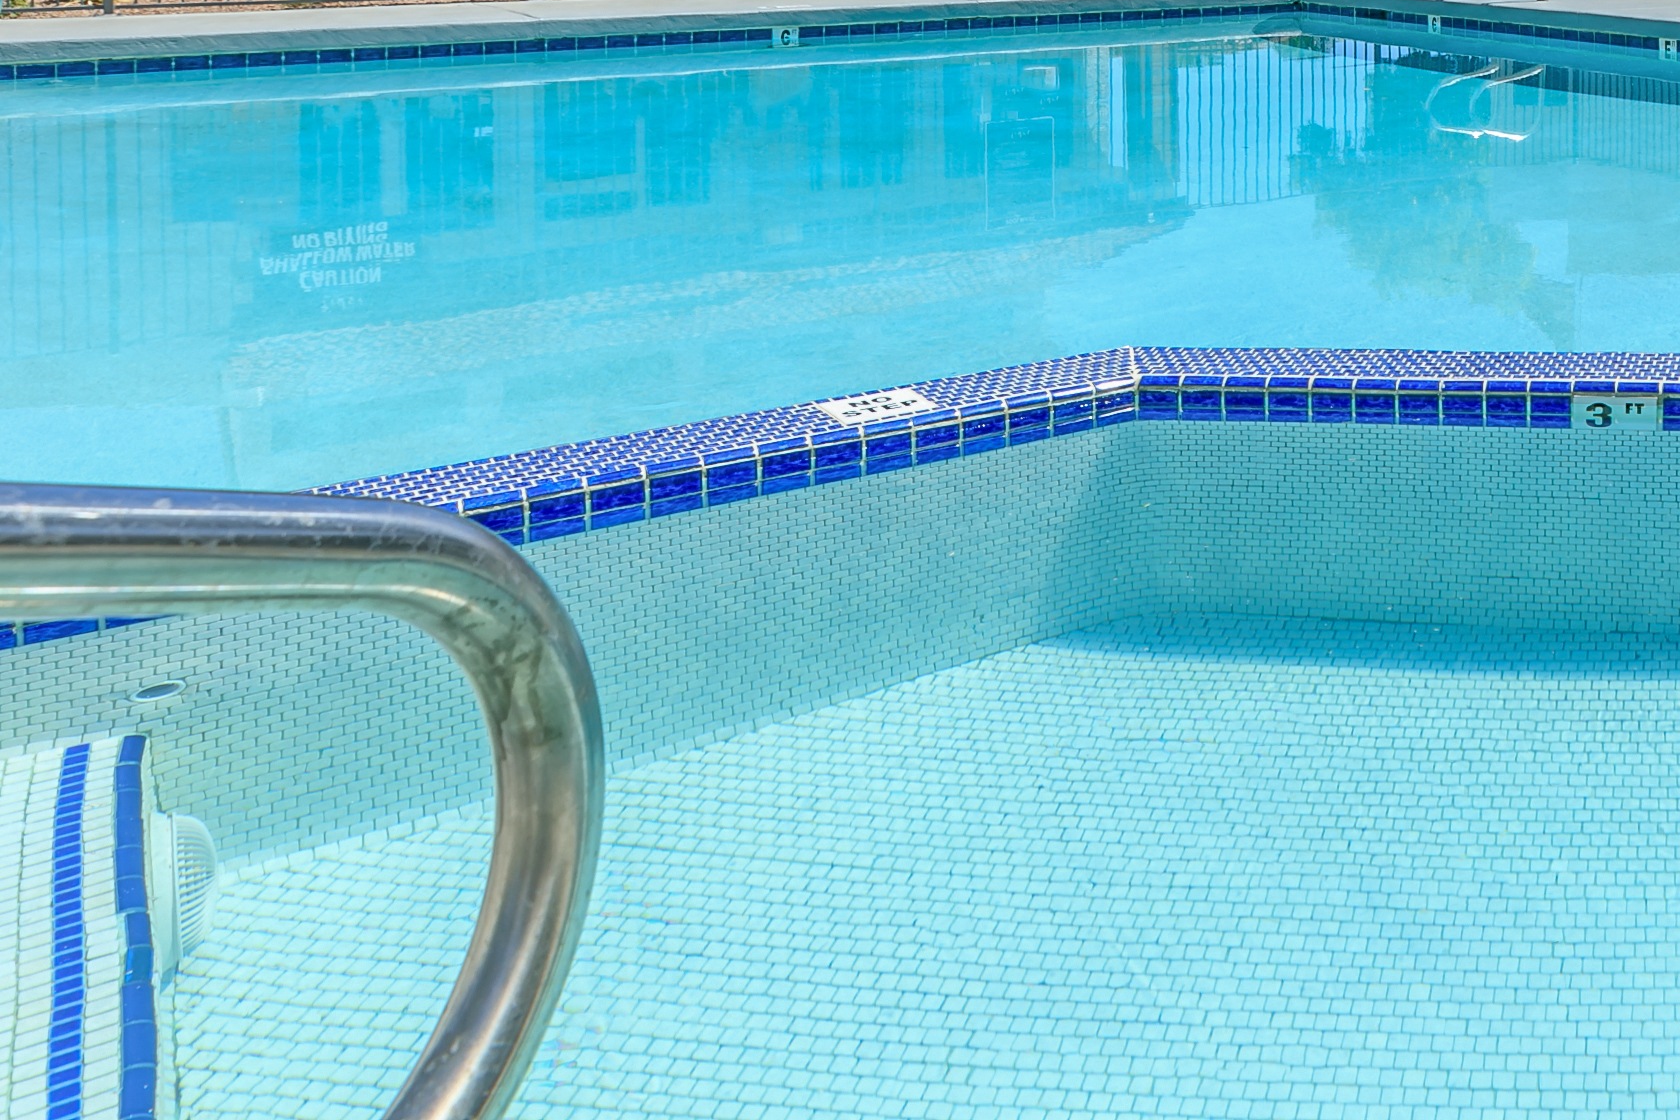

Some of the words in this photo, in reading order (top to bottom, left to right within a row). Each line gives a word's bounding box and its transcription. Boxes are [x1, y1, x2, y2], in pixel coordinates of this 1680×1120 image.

[841, 399, 918, 418] STEP
[847, 396, 893, 408] NO
[1585, 402, 1613, 428] 3
[1625, 402, 1645, 415] FT
